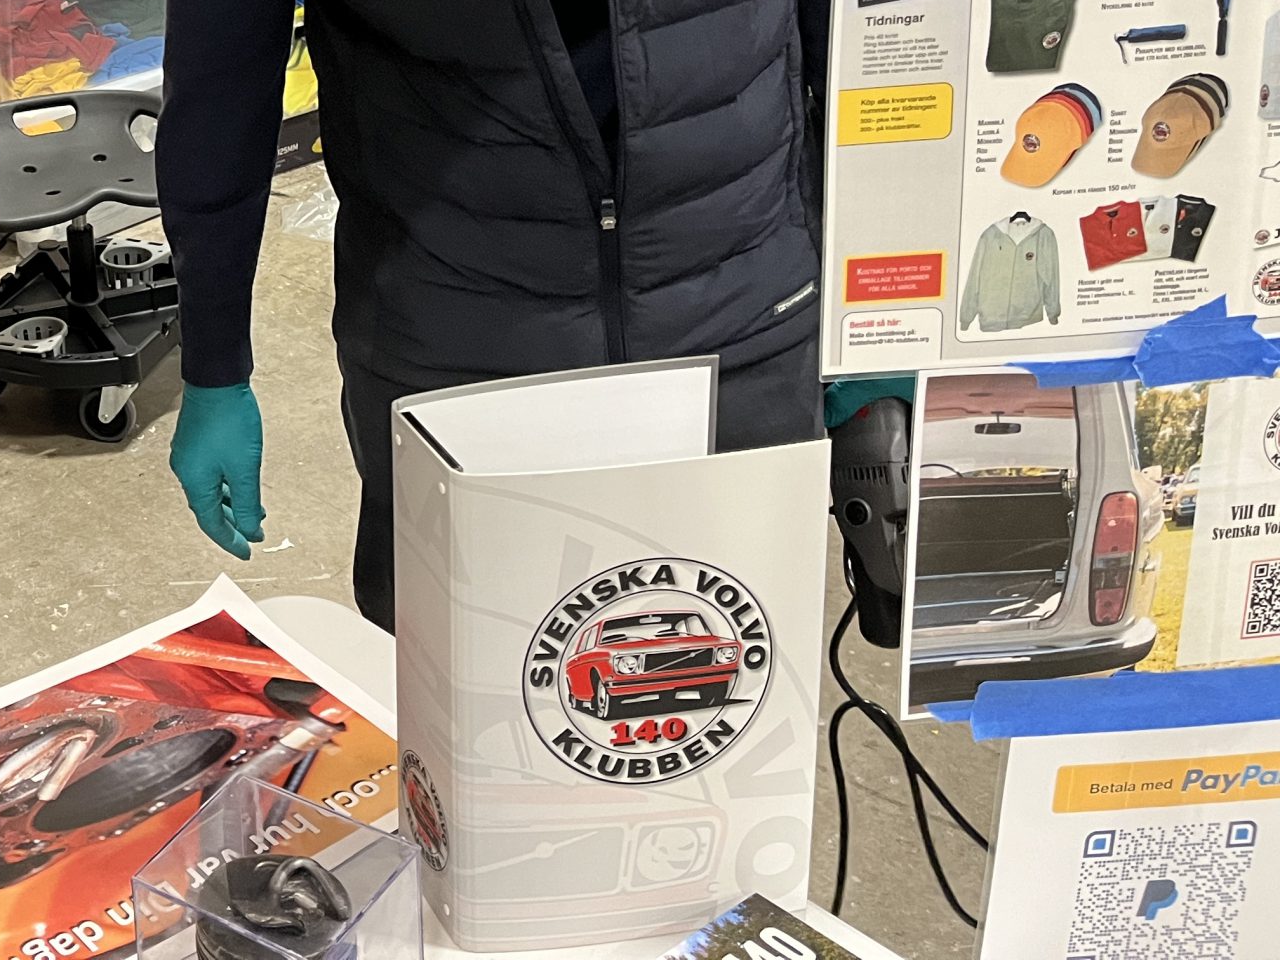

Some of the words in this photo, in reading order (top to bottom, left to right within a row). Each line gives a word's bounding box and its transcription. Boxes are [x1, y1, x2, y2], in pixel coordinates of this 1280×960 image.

[865, 15, 925, 27] Tidningar
[1231, 503, 1253, 521] Vill
[1257, 502, 1275, 518] du
[1212, 525, 1260, 541] Svenska
[530, 564, 676, 688] SVENSKA
[695, 570, 767, 670] VOLVO
[610, 717, 688, 747] 140
[552, 719, 735, 778] KLUBBEN
[1089, 781, 1136, 795] Betala
[1141, 779, 1173, 791] med
[1181, 764, 1280, 794] PayPa
[250, 811, 322, 855] hur
[8, 920, 106, 960] dag
